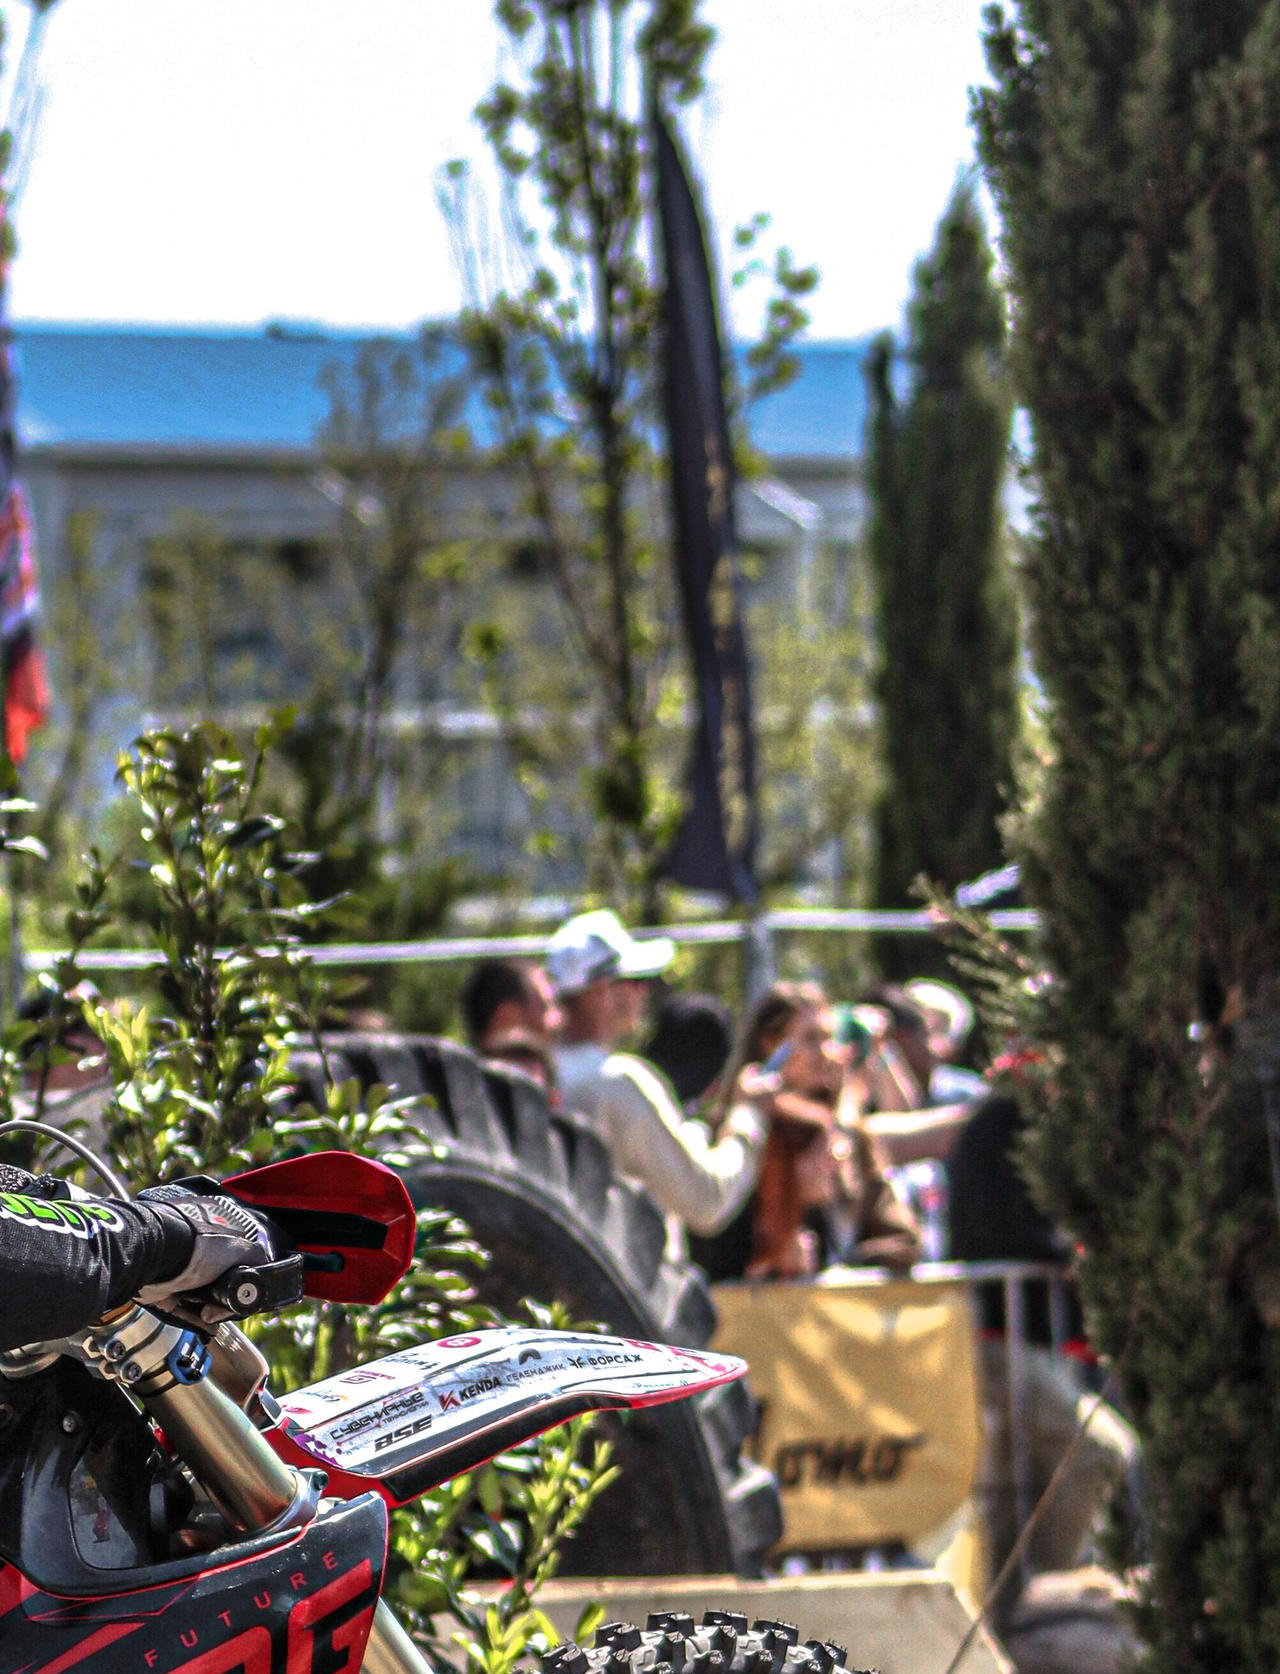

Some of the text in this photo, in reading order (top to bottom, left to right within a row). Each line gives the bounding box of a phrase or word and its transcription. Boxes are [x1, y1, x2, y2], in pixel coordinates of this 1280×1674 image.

[505, 1362, 566, 1383] ГЕЛЕНДЖИК
[587, 1353, 645, 1368] ФОРСАЖ
[459, 1375, 502, 1402] KENDA
[329, 1391, 425, 1441] СУВЕНИРНЫЕ
[375, 1414, 433, 1452] BSE
[143, 1550, 339, 1669] FUTURE
